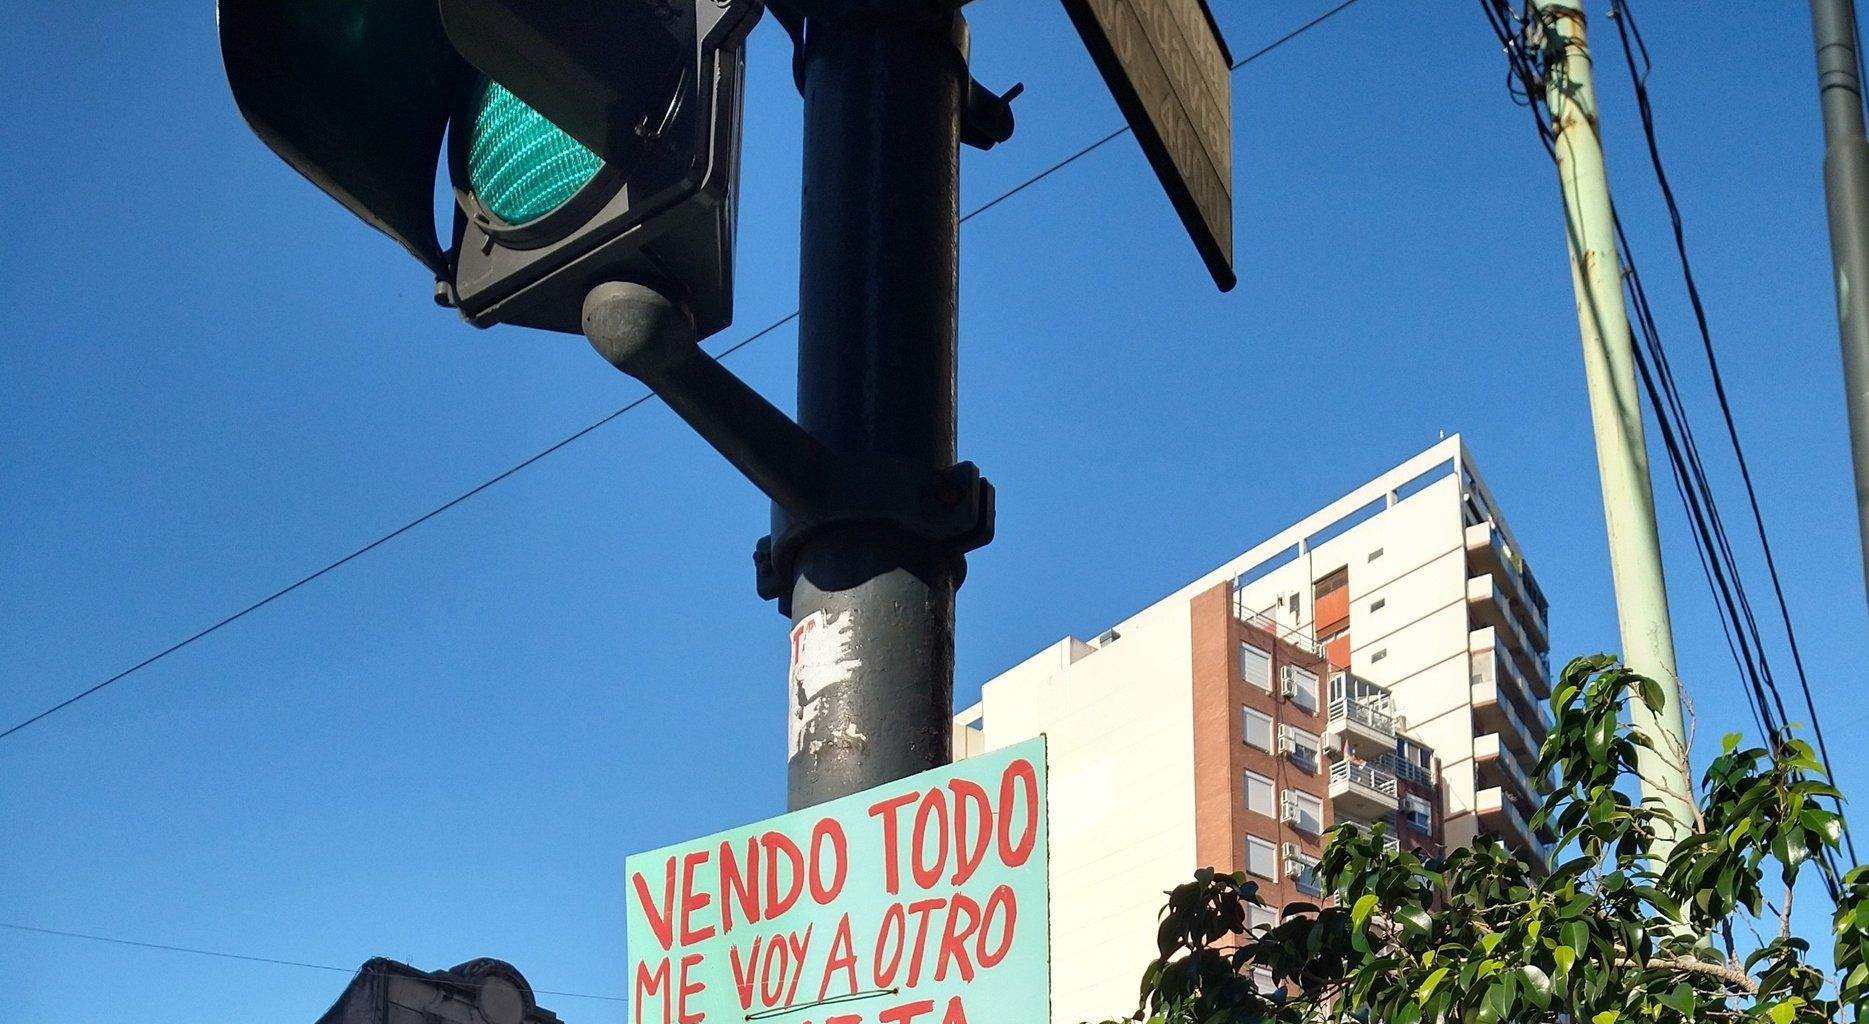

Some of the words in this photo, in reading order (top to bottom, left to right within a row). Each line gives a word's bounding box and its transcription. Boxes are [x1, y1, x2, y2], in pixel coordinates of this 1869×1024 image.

[632, 817, 848, 951] VENDO
[868, 758, 1039, 895] TODO
[730, 922, 813, 1011] VOY
[818, 912, 858, 1005] A
[872, 884, 1017, 989] OTRO
